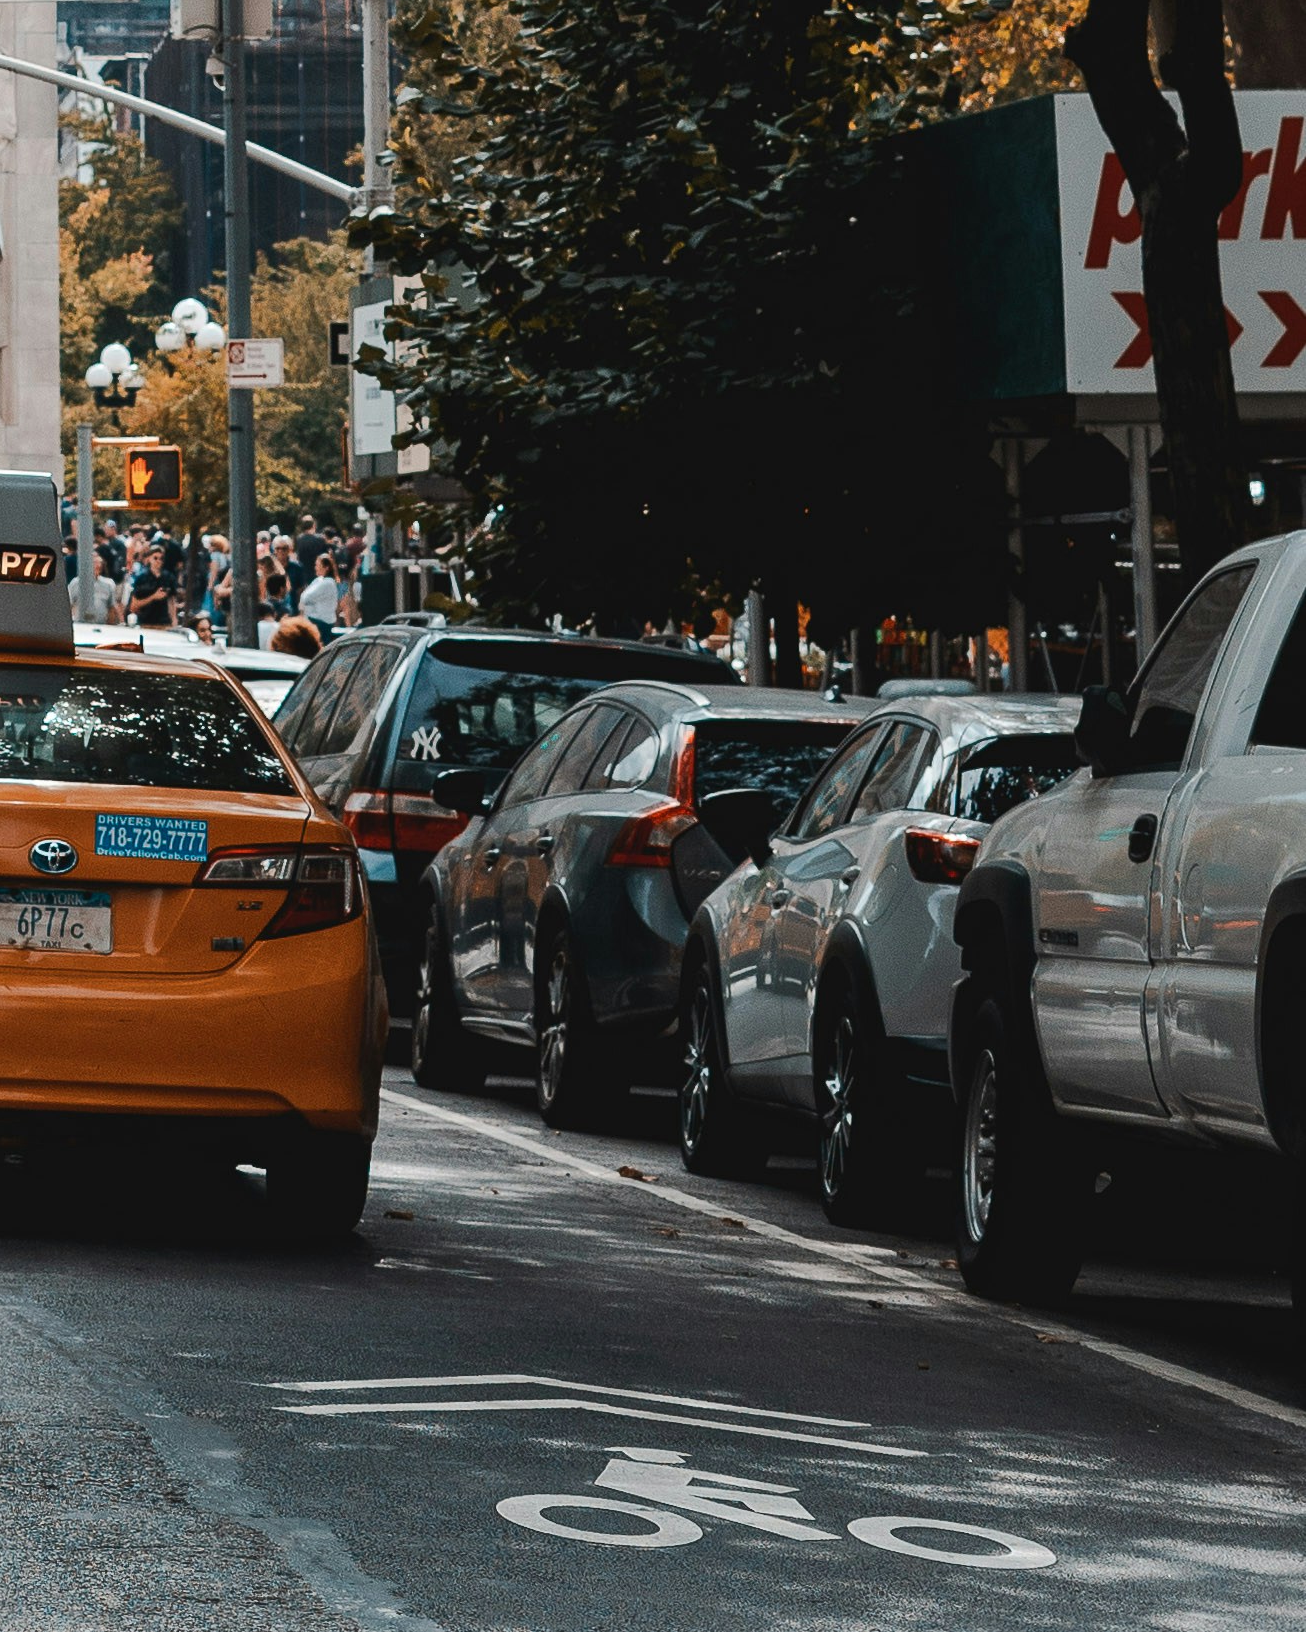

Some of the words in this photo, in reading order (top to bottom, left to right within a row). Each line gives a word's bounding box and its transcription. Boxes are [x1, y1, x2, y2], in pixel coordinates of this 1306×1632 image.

[1084, 116, 1306, 270] prk
[98, 814, 152, 827] DRIVERS
[155, 818, 207, 831] WANTED
[97, 826, 206, 852] 718-729-7777
[96, 847, 207, 862] DriveYellowCab.com
[20, 891, 46, 904] NEW
[51, 891, 83, 906] YORK
[40, 939, 62, 949] TAXI
